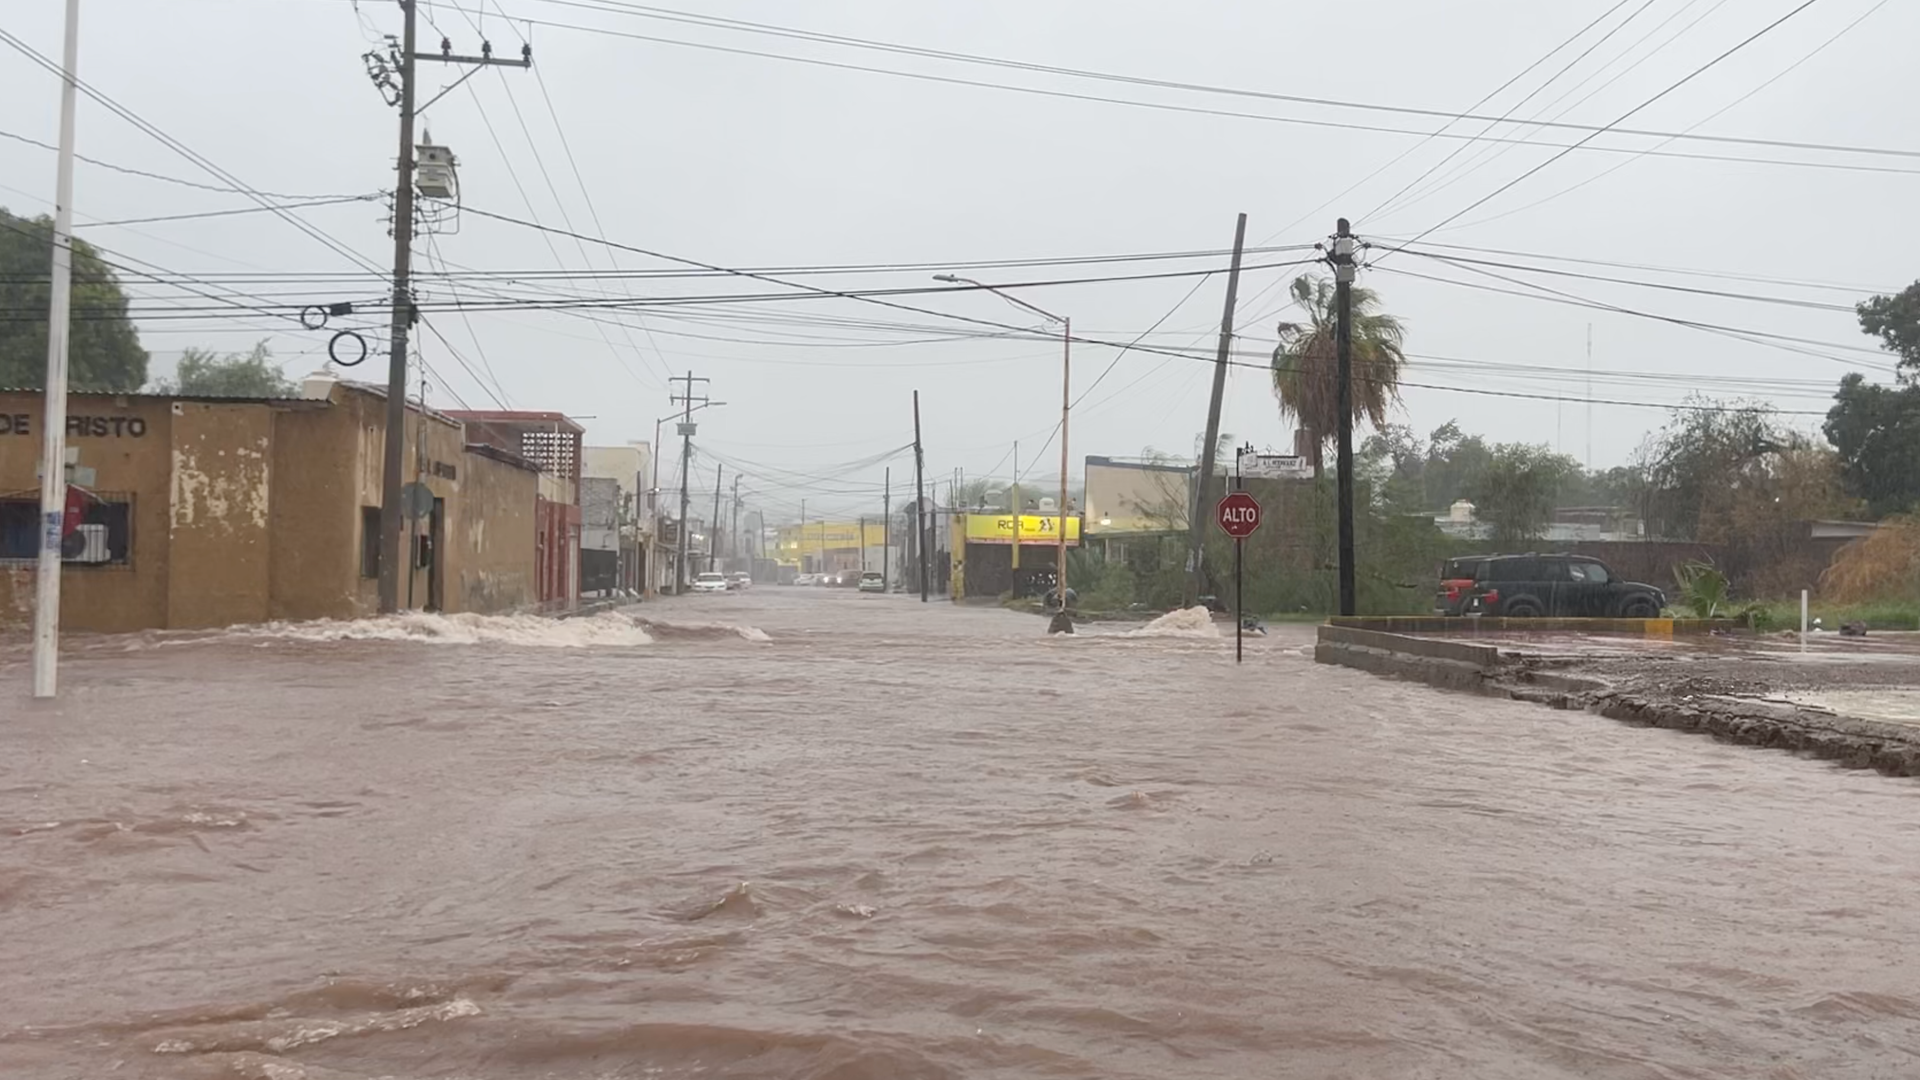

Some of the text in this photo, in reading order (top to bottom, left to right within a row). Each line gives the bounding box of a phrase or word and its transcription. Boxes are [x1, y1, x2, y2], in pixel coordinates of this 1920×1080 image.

[0, 413, 147, 438] DE RISTO
[1222, 507, 1256, 523] ALTO
